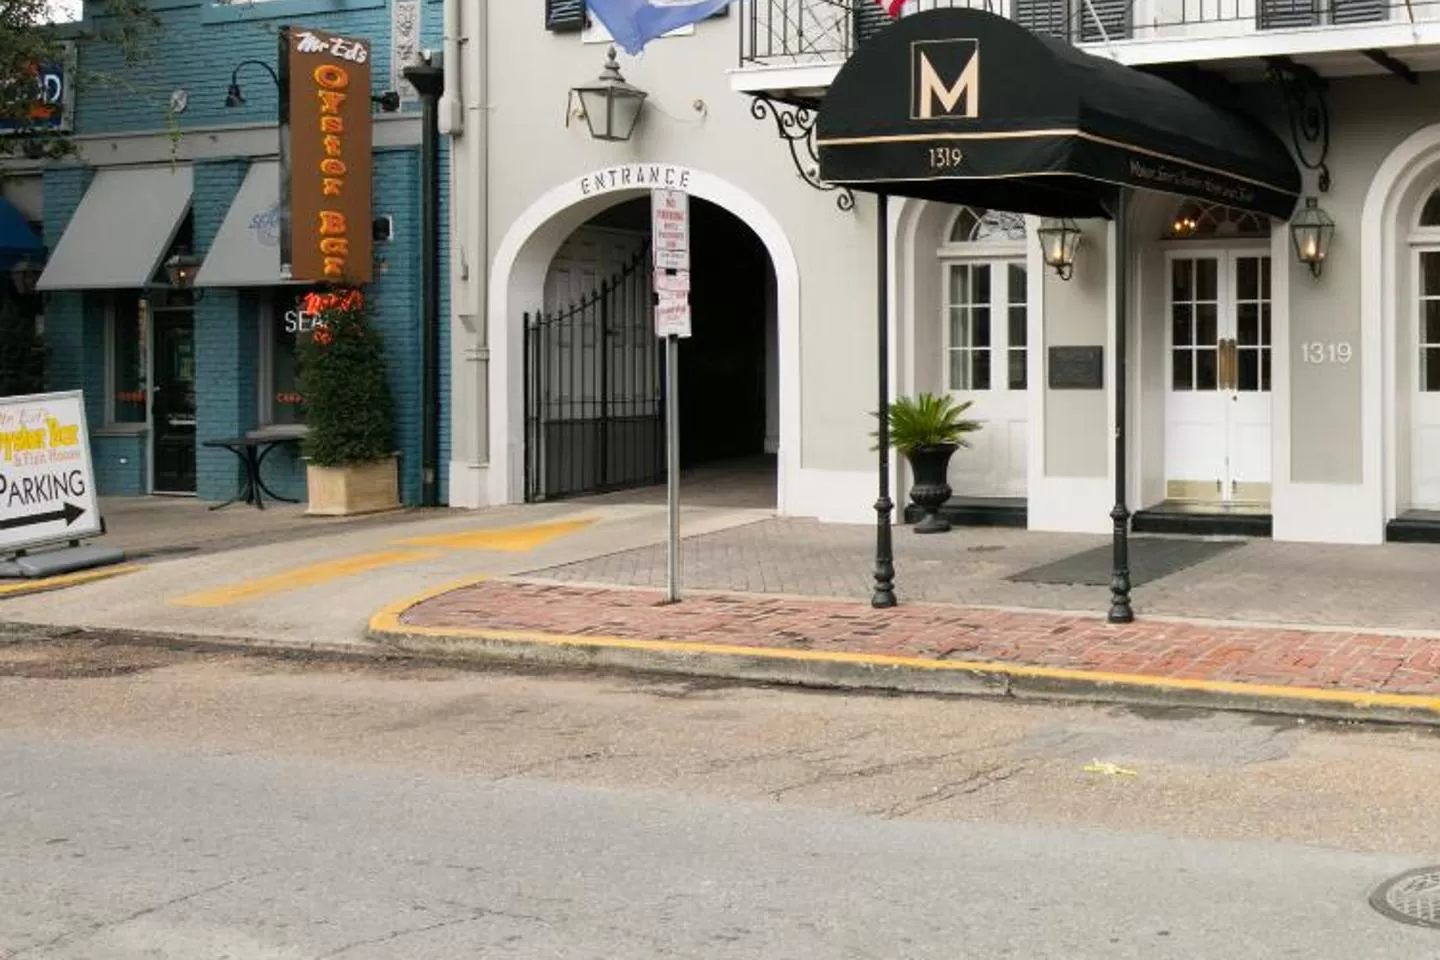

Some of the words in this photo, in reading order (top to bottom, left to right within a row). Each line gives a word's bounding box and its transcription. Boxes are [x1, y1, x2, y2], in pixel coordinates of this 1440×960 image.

[296, 31, 330, 54] Mr
[329, 37, 368, 64] Ed's
[920, 49, 979, 120] M
[314, 64, 350, 196] OYSTER
[928, 146, 963, 168] 1319
[581, 166, 690, 195] ENTRANCE
[319, 210, 349, 276] BAR
[1300, 341, 1354, 363] 1319
